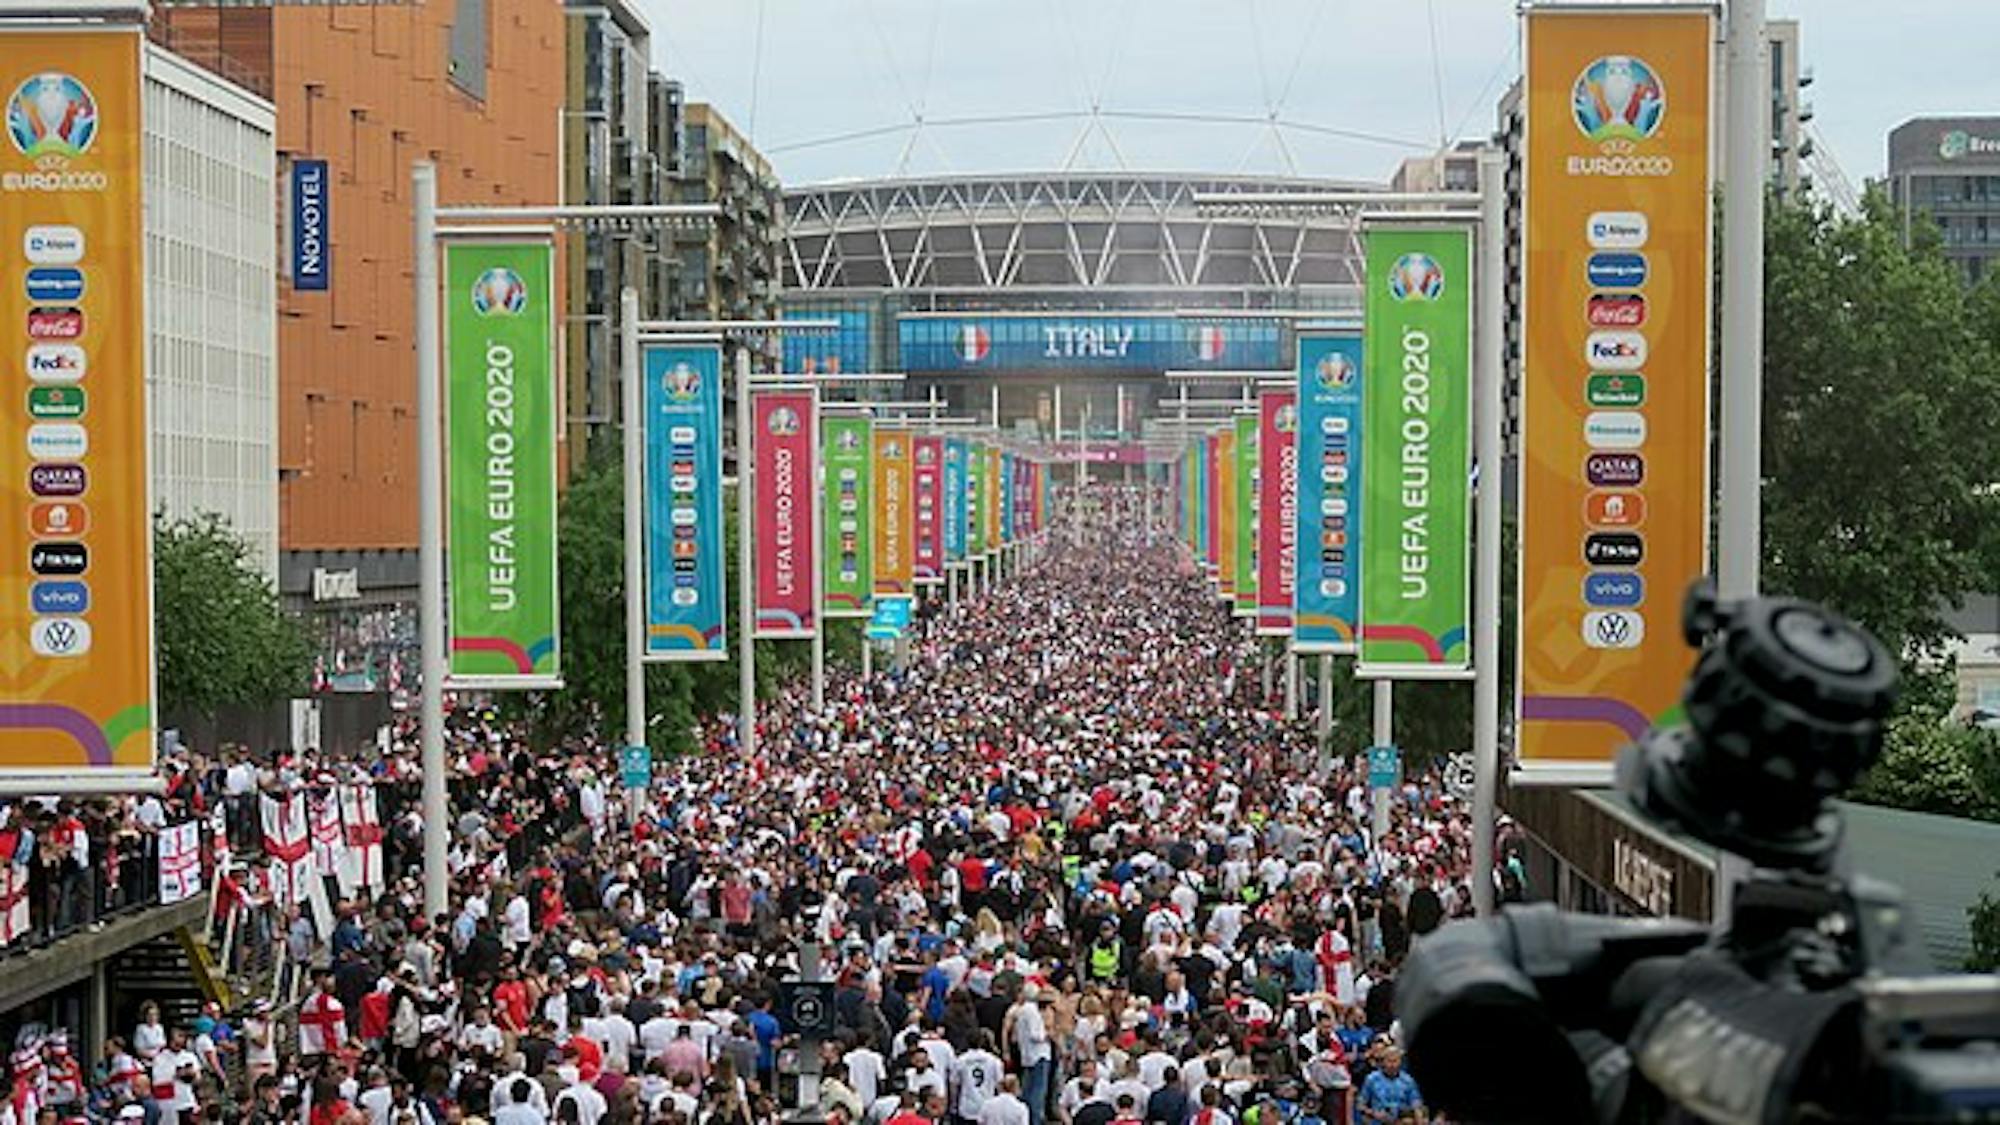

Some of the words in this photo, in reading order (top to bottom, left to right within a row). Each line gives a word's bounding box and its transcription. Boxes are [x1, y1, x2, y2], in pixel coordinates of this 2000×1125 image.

[301, 167, 320, 274] NOVOTEL
[1044, 326, 1133, 357] ITALY
[1402, 331, 1429, 414] 2020
[487, 345, 516, 427] 2020
[487, 432, 516, 520] EURO
[776, 448, 792, 495] 2020
[1402, 419, 1429, 508] EURO
[776, 496, 792, 545] EURO
[1402, 513, 1429, 599] UEFA
[487, 525, 516, 611] UEFA
[776, 547, 792, 596] UEFA
[972, 1068, 984, 1087] 9
